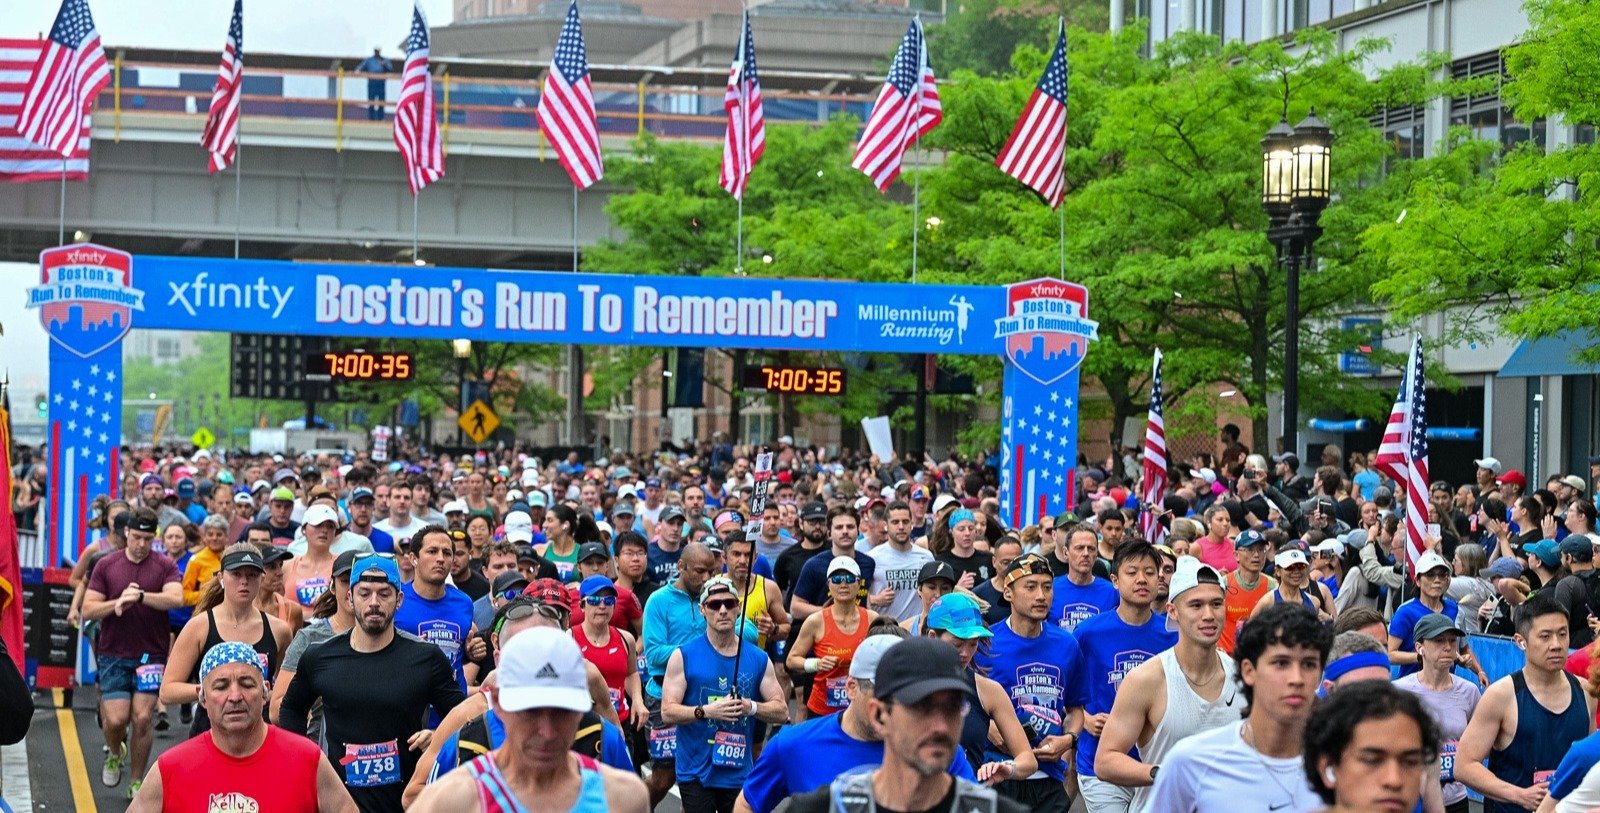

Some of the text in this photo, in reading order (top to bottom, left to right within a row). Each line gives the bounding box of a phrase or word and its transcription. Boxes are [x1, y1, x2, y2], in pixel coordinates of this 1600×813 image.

[67, 250, 107, 264] xfinity
[58, 267, 114, 283] Boston's
[31, 287, 139, 305] Run To Remember
[168, 272, 294, 319] xfinity
[1031, 285, 1066, 298] xfinity
[316, 274, 838, 338] Boston's Run To Remember
[858, 304, 955, 322] Millennium
[1023, 299, 1072, 314] Boston's
[880, 322, 954, 345] Running
[999, 316, 1094, 337] Run To Remember
[1002, 395, 1013, 517] START
[1024, 675, 1052, 685] Boston's
[833, 689, 848, 699] 50
[1029, 715, 1052, 735] 981
[717, 744, 746, 759] 4084
[352, 757, 395, 775] 1738
